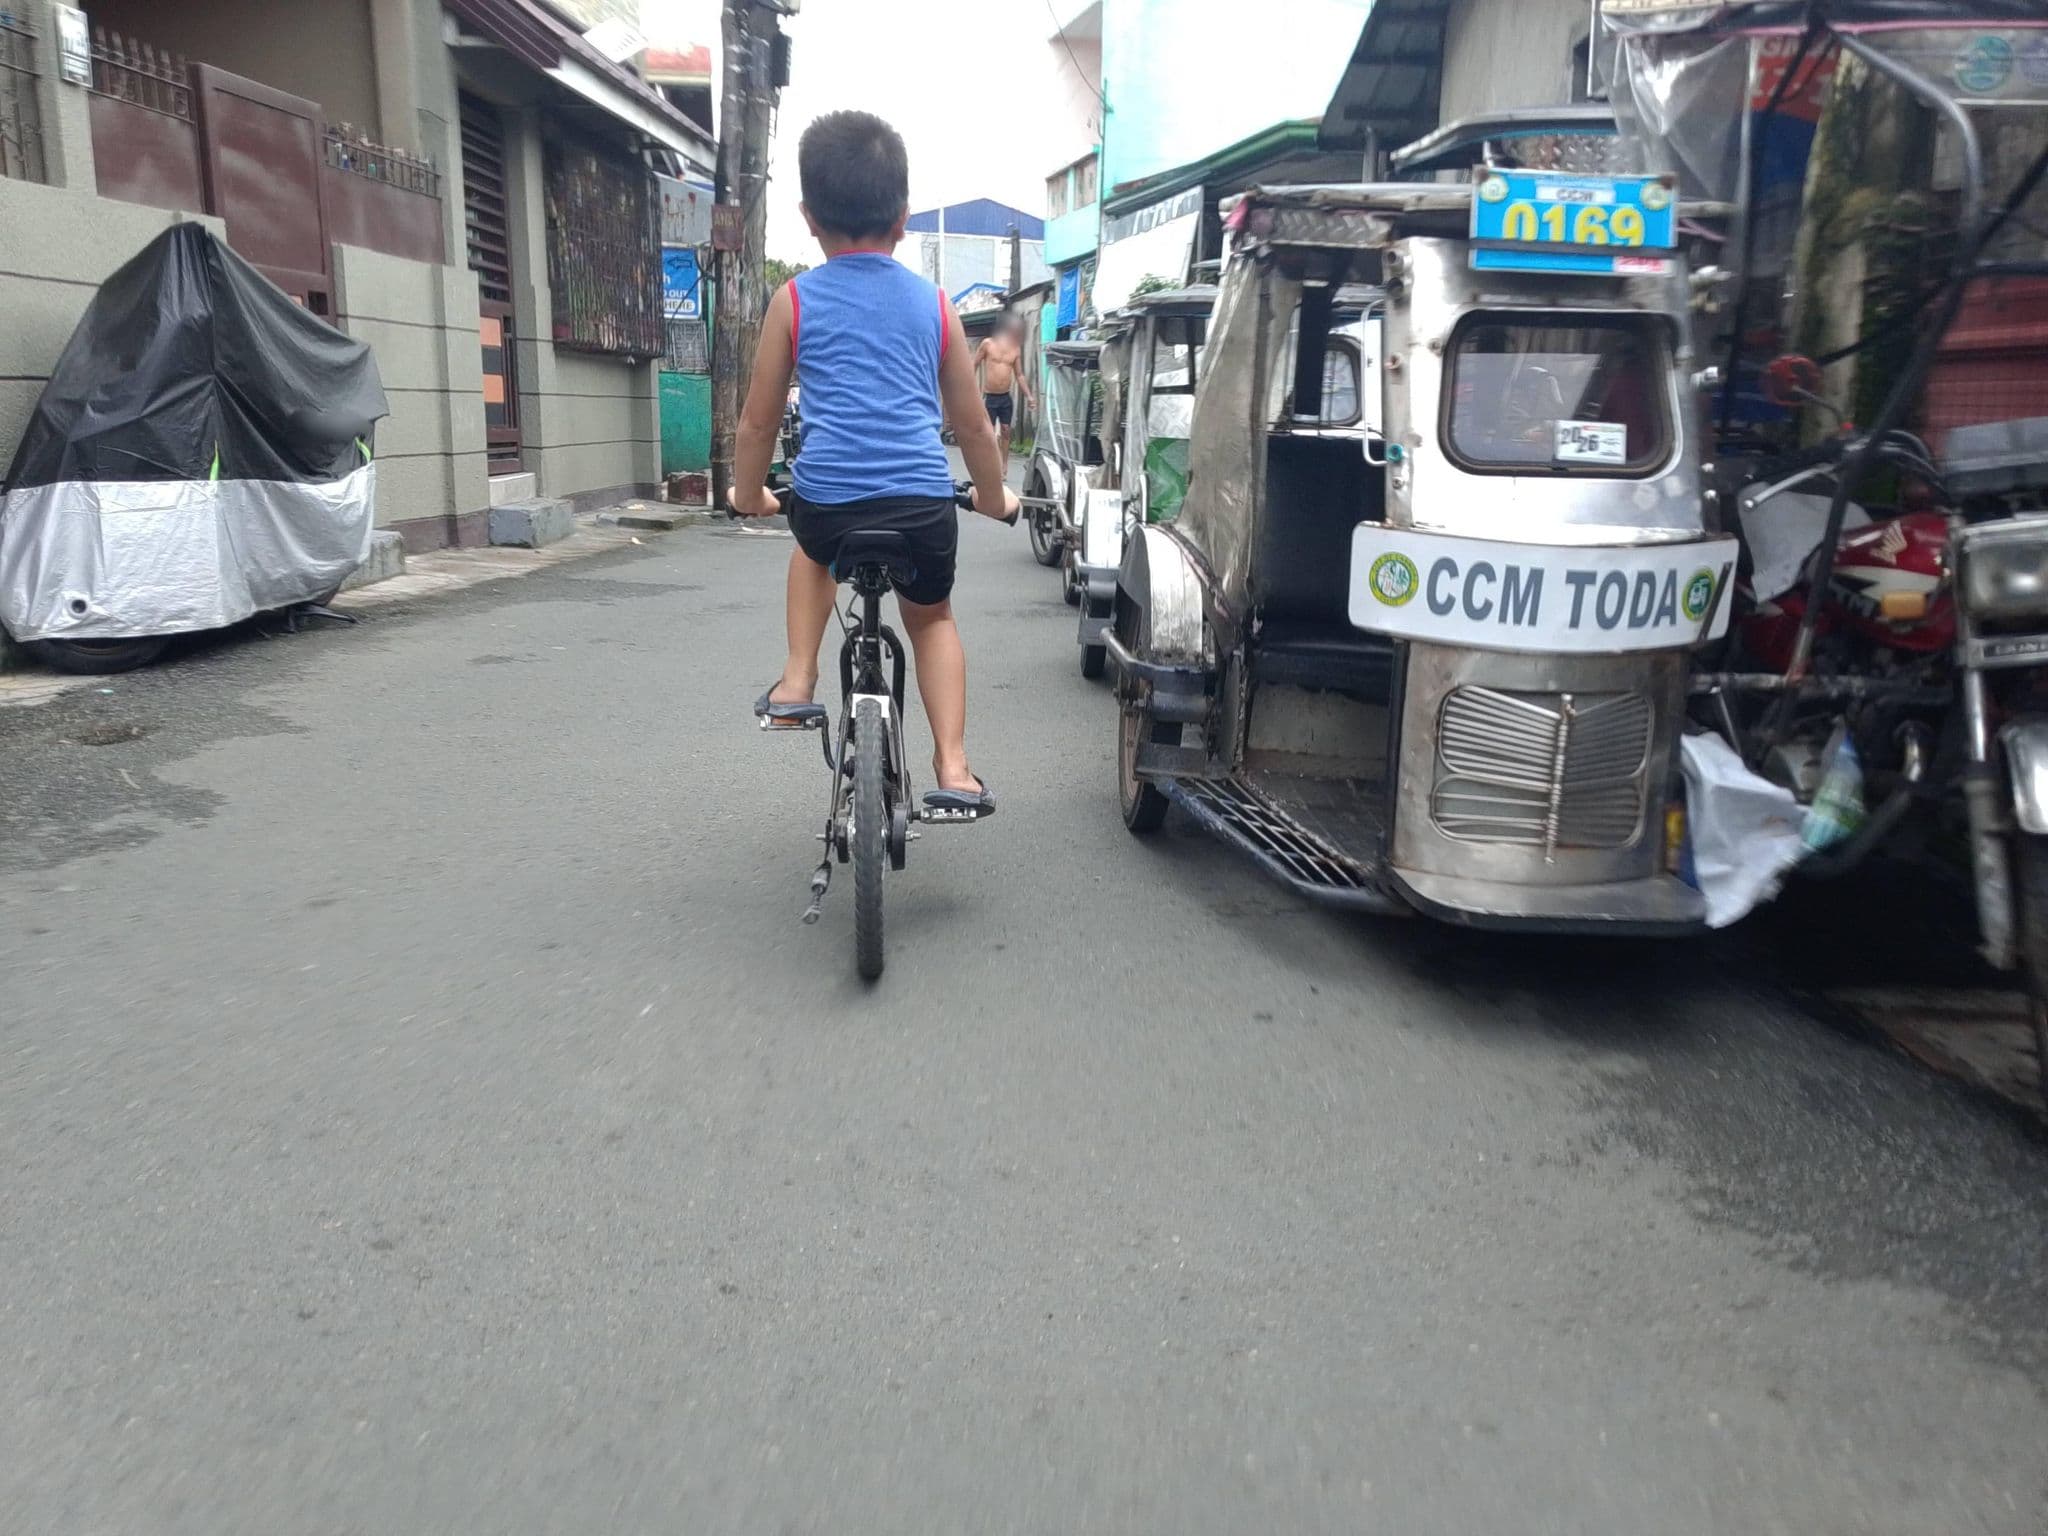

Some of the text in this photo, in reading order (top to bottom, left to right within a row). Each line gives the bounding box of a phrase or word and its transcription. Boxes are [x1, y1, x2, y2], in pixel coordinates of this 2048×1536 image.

[1502, 203, 1645, 247] 0169
[1426, 557, 1544, 627] CCM
[1564, 567, 1678, 631] TODA
